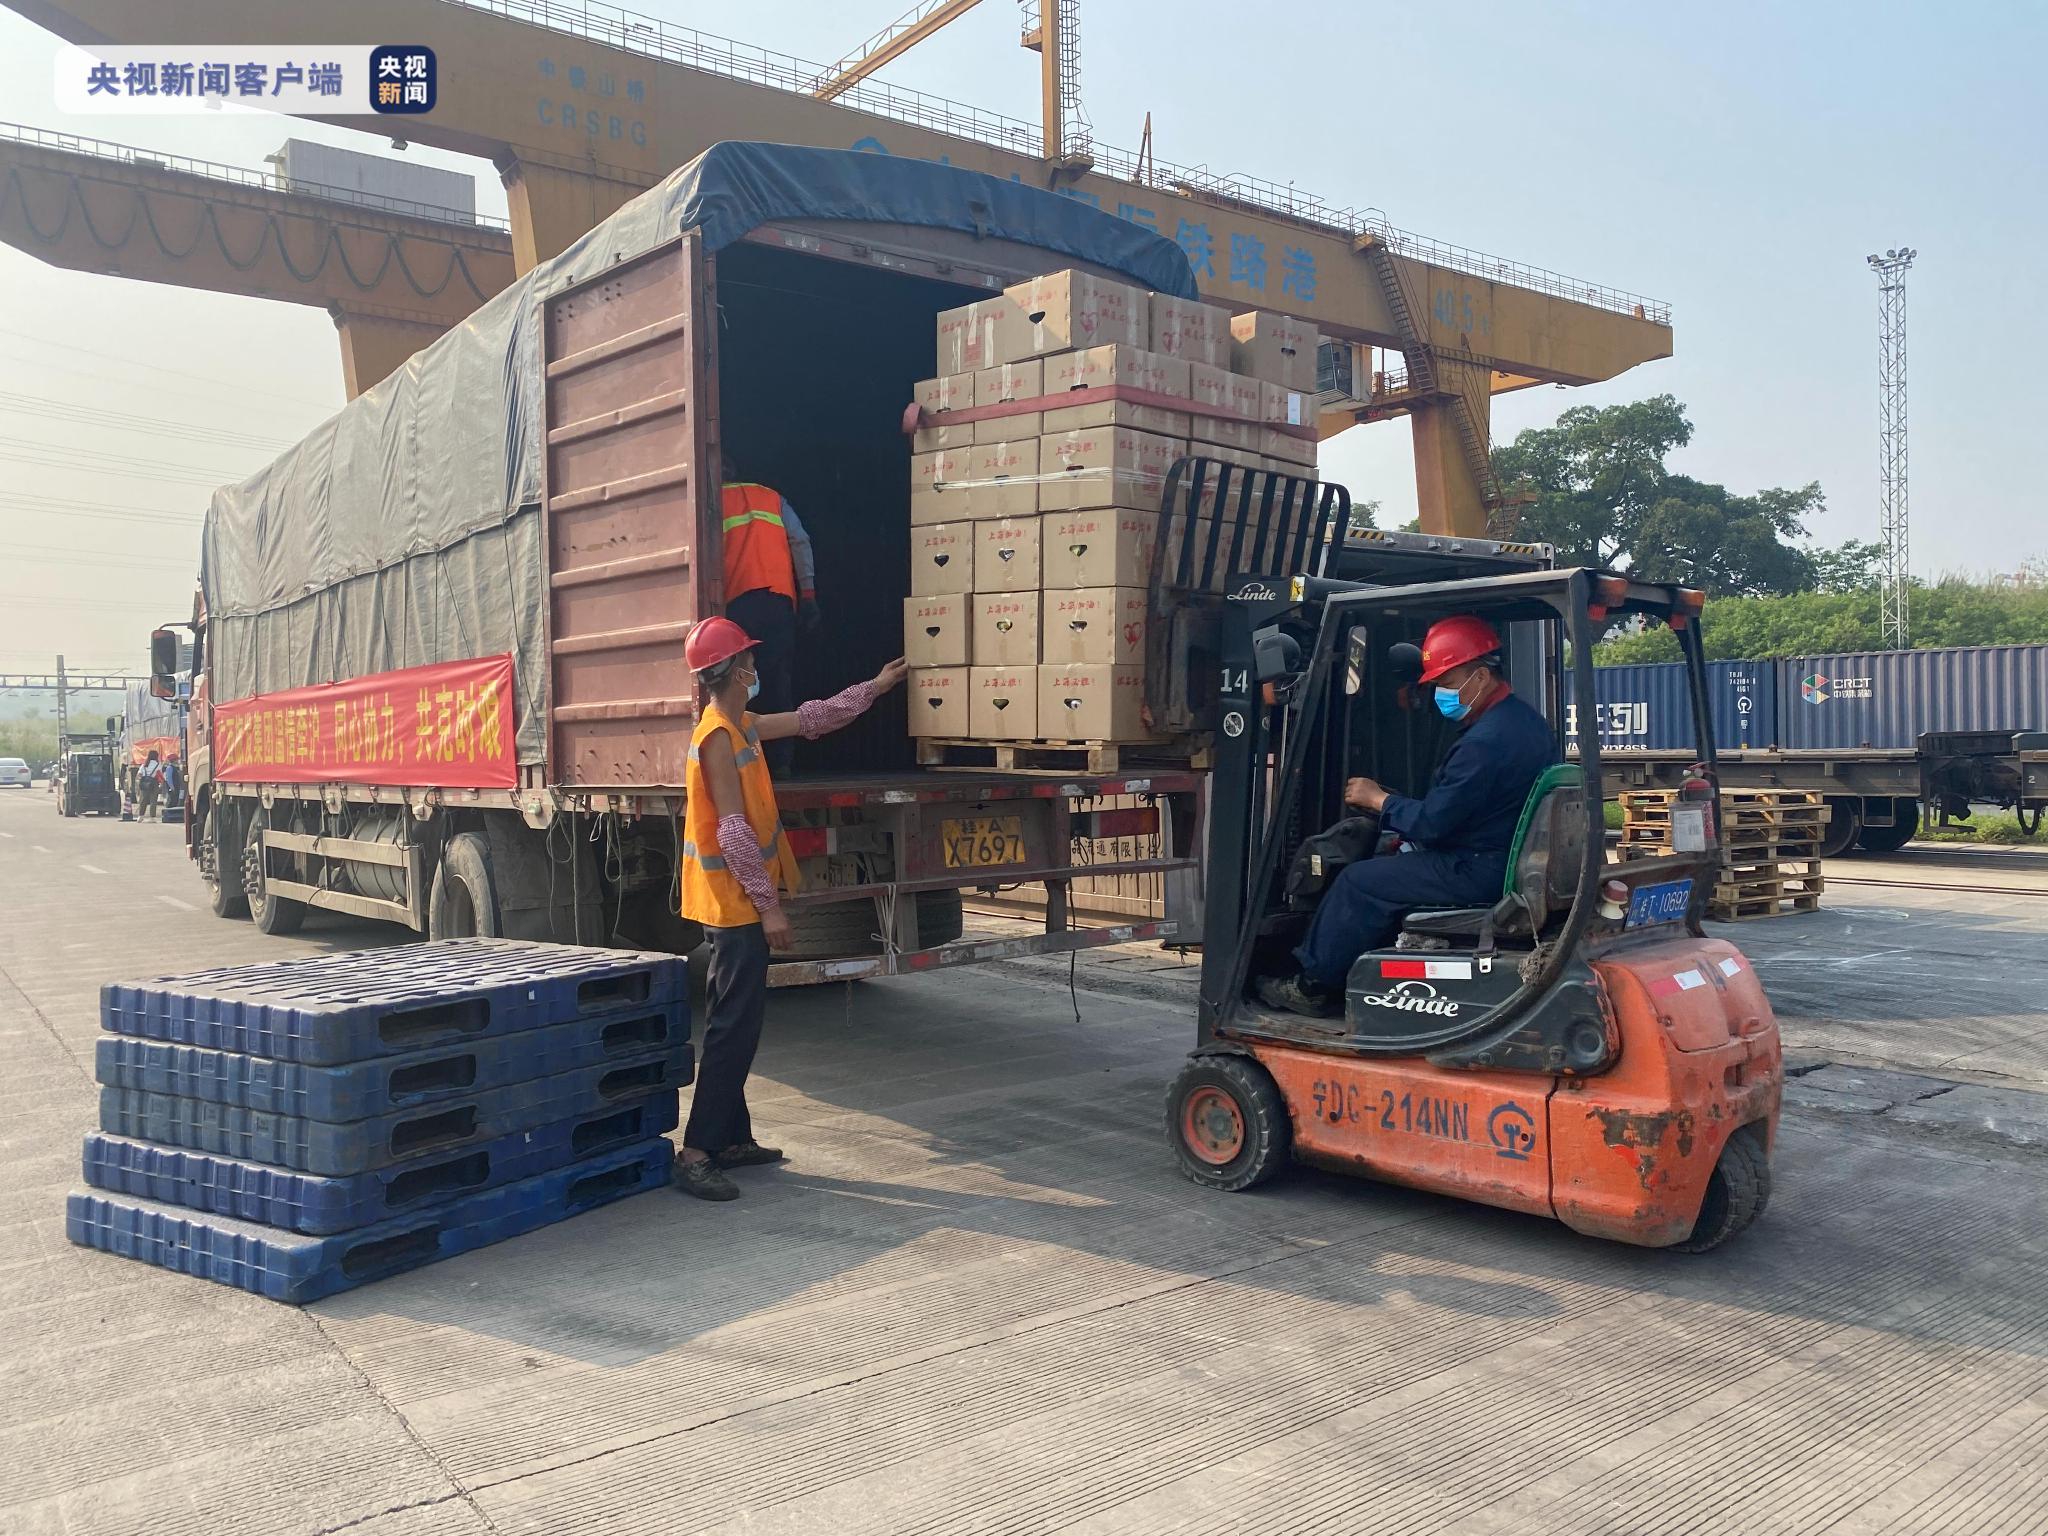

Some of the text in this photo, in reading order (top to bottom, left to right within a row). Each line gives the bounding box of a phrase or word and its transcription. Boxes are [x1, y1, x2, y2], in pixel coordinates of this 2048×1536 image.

[536, 96, 648, 147] CRSBG
[1226, 582, 1277, 601] Linde
[1220, 667, 1249, 694] 14
[1833, 677, 1873, 689] CRCT
[2028, 775, 2037, 784] 2
[946, 834, 1020, 867] X7697
[1363, 980, 1460, 1017] Linde
